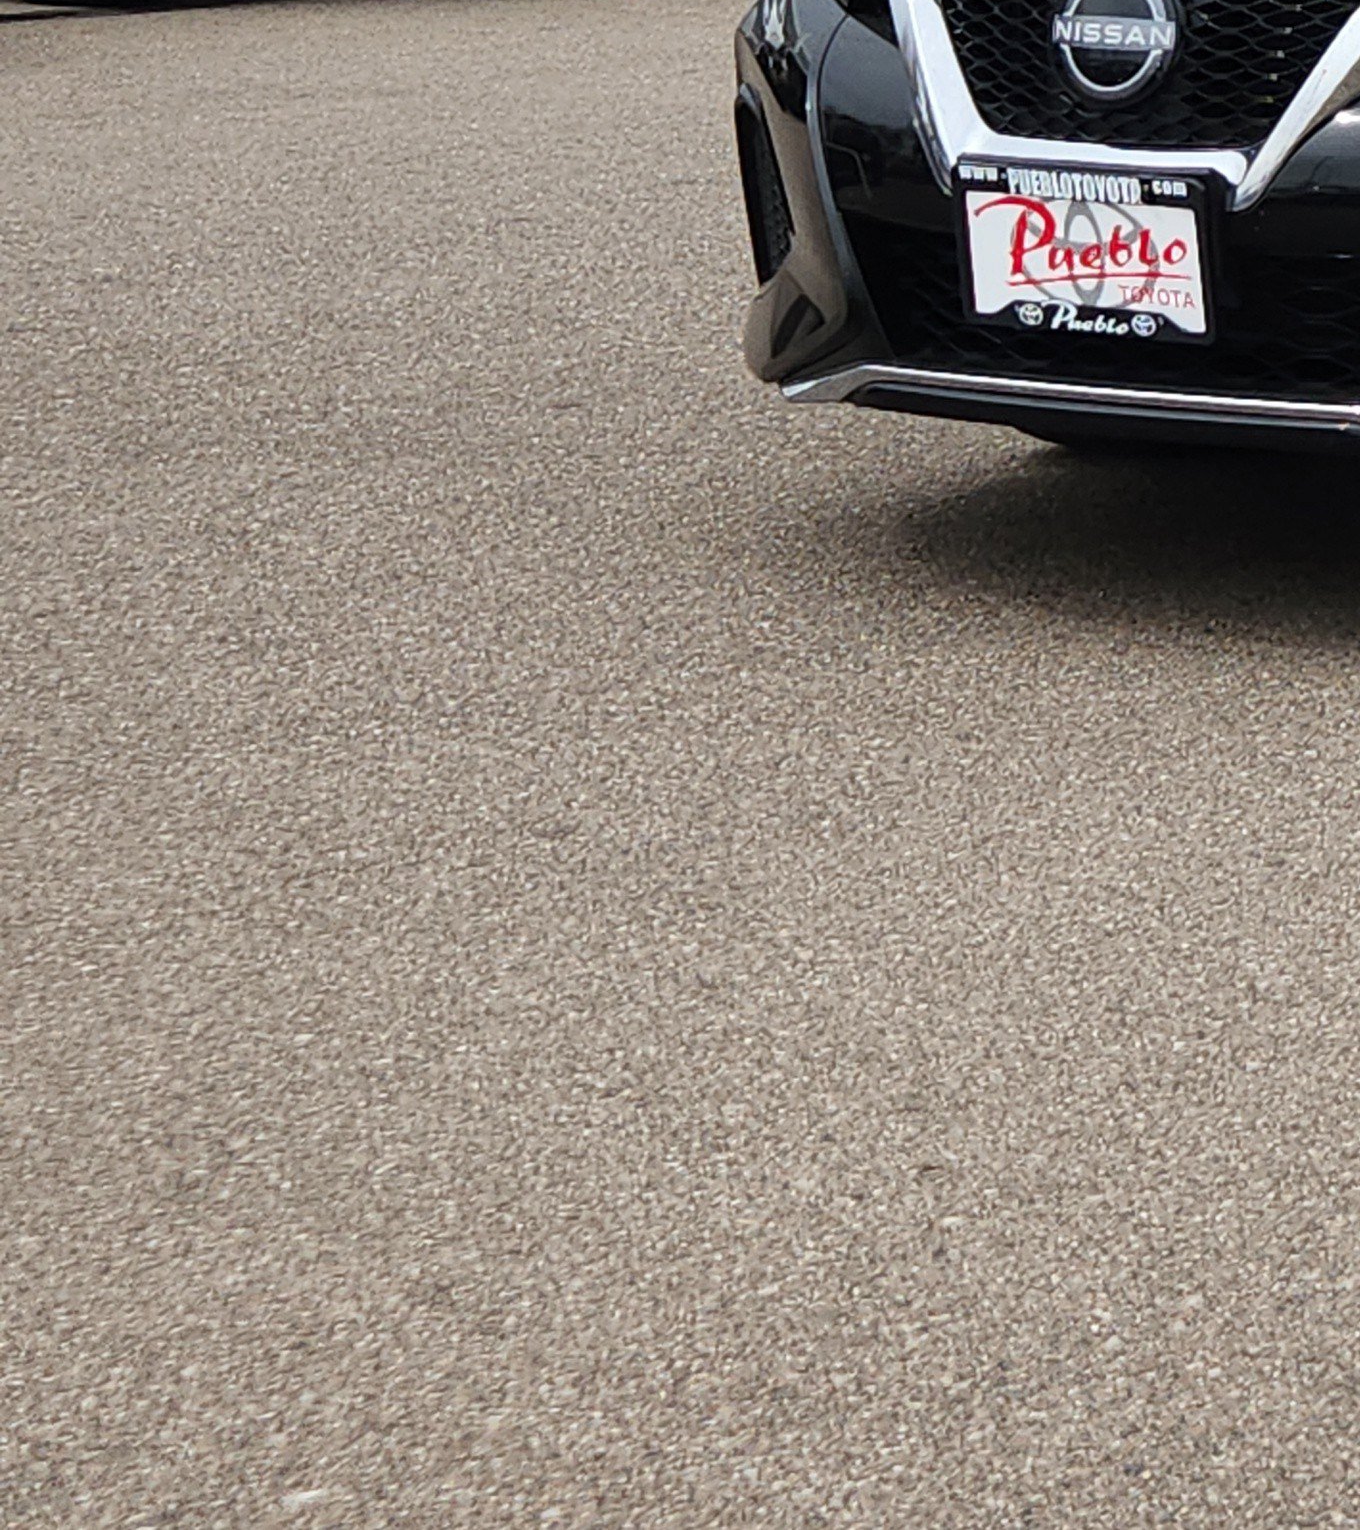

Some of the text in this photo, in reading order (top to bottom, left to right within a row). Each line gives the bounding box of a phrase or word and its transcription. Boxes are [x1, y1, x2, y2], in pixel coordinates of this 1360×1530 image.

[1054, 20, 1172, 46] NISSAN
[973, 196, 1188, 275] Pueblo
[1117, 285, 1196, 308] TOYOTA
[1041, 301, 1130, 335] Pueblo
